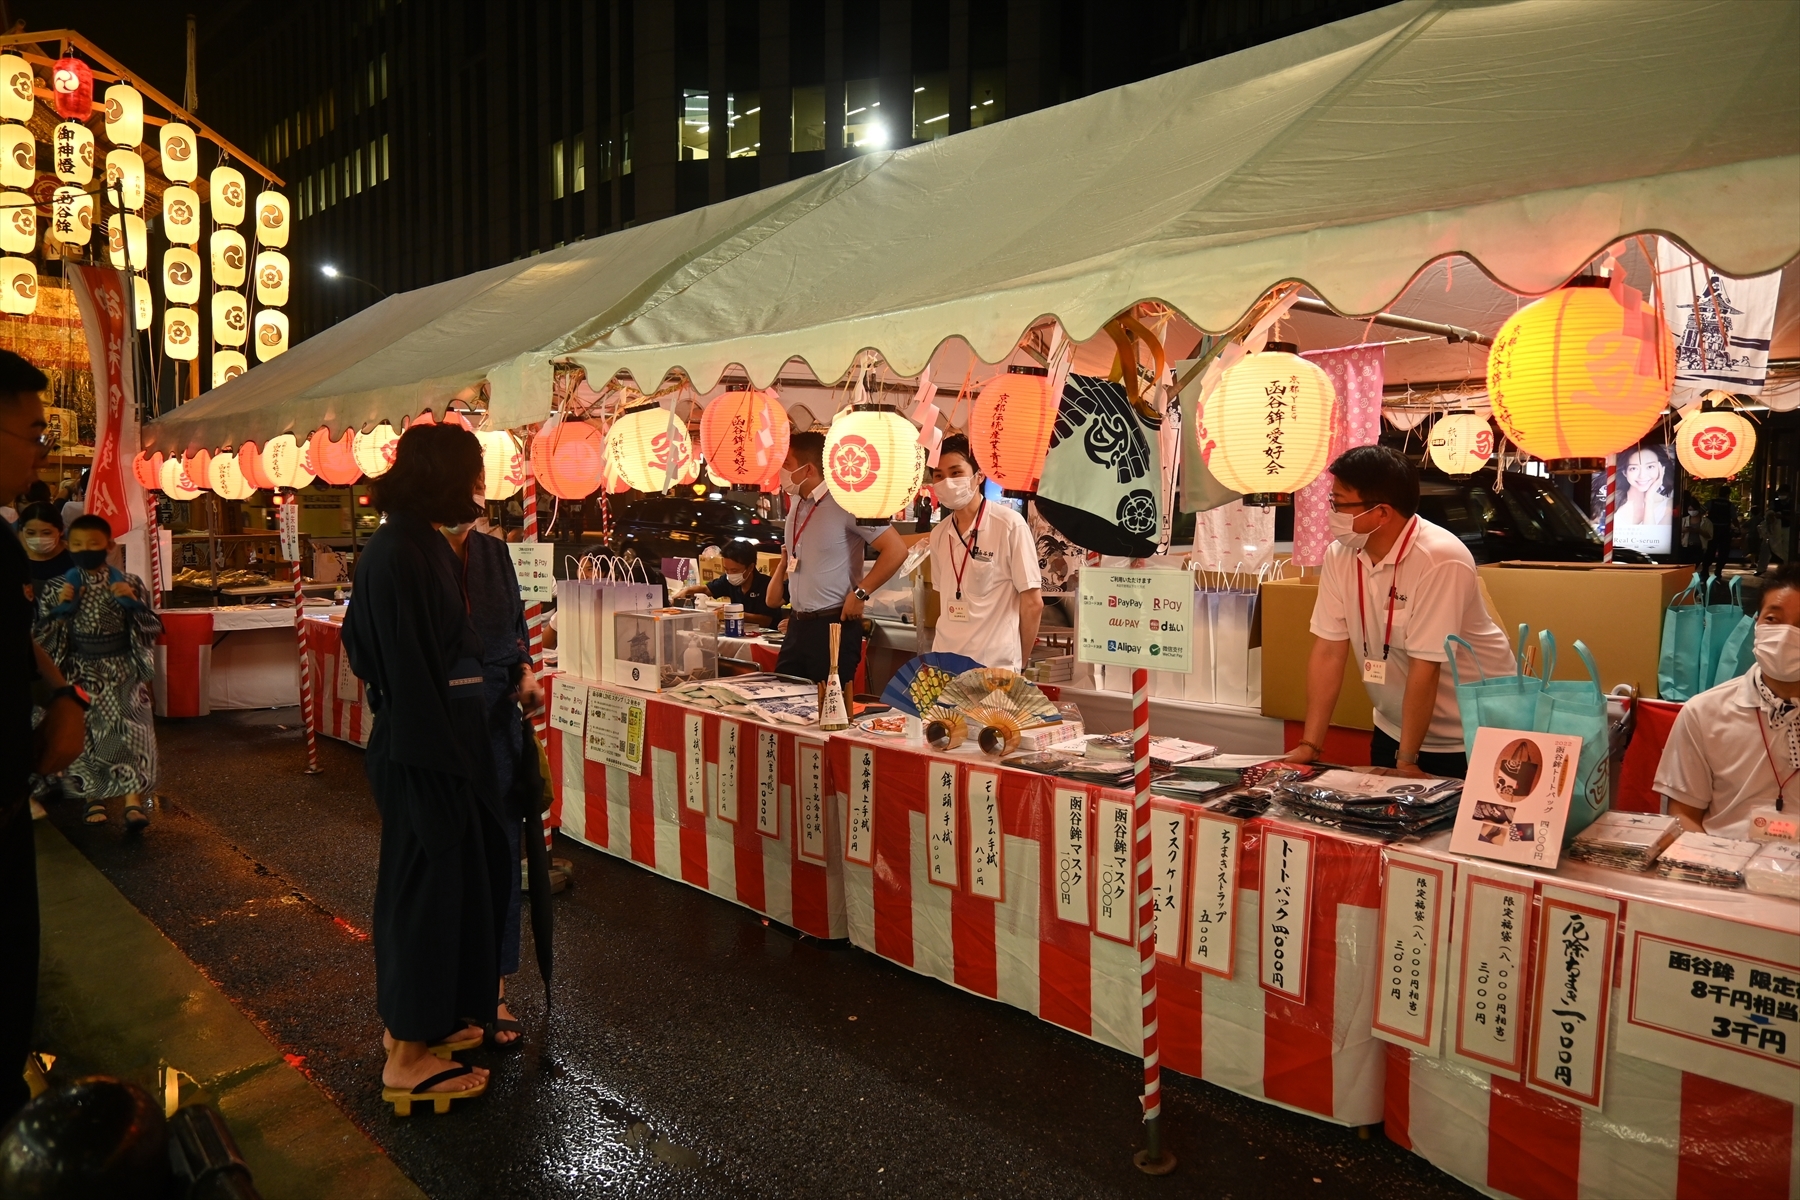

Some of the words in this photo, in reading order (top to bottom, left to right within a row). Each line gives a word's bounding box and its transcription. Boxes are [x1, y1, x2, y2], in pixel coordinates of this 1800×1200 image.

[58, 125, 76, 175] 御神燈
[55, 191, 75, 234] 函谷鉾
[1289, 375, 1300, 422] 京都YEG
[1263, 380, 1290, 475] 函谷鉾愛好会
[1110, 576, 1152, 584] ご利用いただけます
[1117, 598, 1143, 608] PayPay
[1108, 618, 1124, 627] au
[1125, 619, 1140, 628] PAY
[1161, 621, 1184, 632] d払い
[1163, 599, 1182, 612] Pay
[1117, 642, 1142, 654] Alipay
[812, 752, 822, 834] 令和四年記念手拭
[940, 770, 953, 846] 鉾頭手拭
[1069, 795, 1083, 886] 函谷鉾マスク
[1113, 807, 1128, 899] 函谷鉾マスク
[1164, 820, 1180, 909] マスクケース
[1215, 829, 1231, 923] ちまきストラップ
[1198, 909, 1212, 958] 五〇〇円
[1668, 950, 1735, 983] 函谷鉾
[1749, 969, 1800, 1000] 限定
[1711, 1016, 1787, 1055] 3千円
